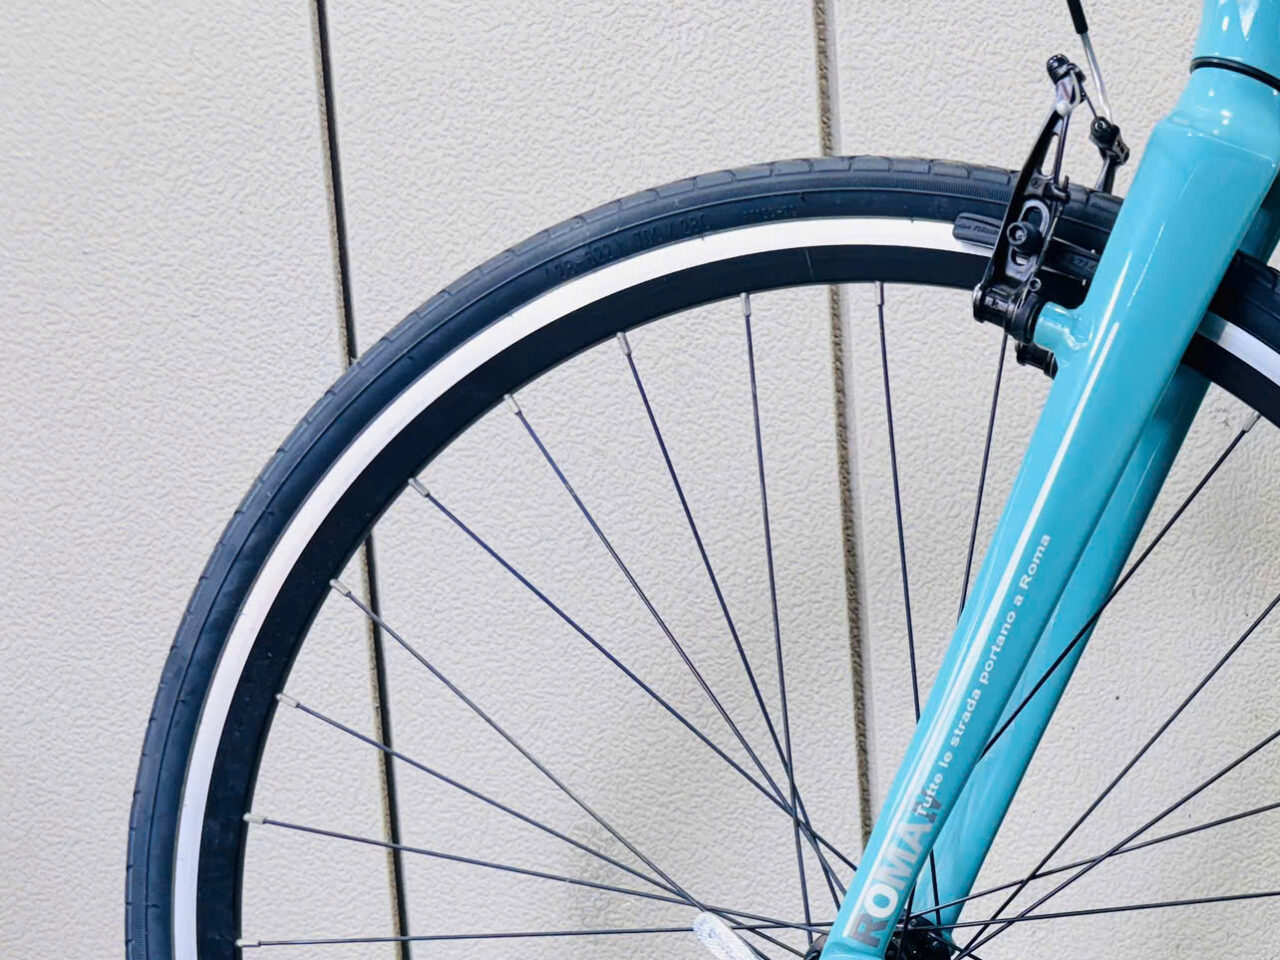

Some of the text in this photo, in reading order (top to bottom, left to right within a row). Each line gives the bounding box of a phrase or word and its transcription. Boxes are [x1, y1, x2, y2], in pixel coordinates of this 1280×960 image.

[915, 534, 1051, 817] Tutte le strada portano a Roma
[849, 822, 934, 948] ROMA
